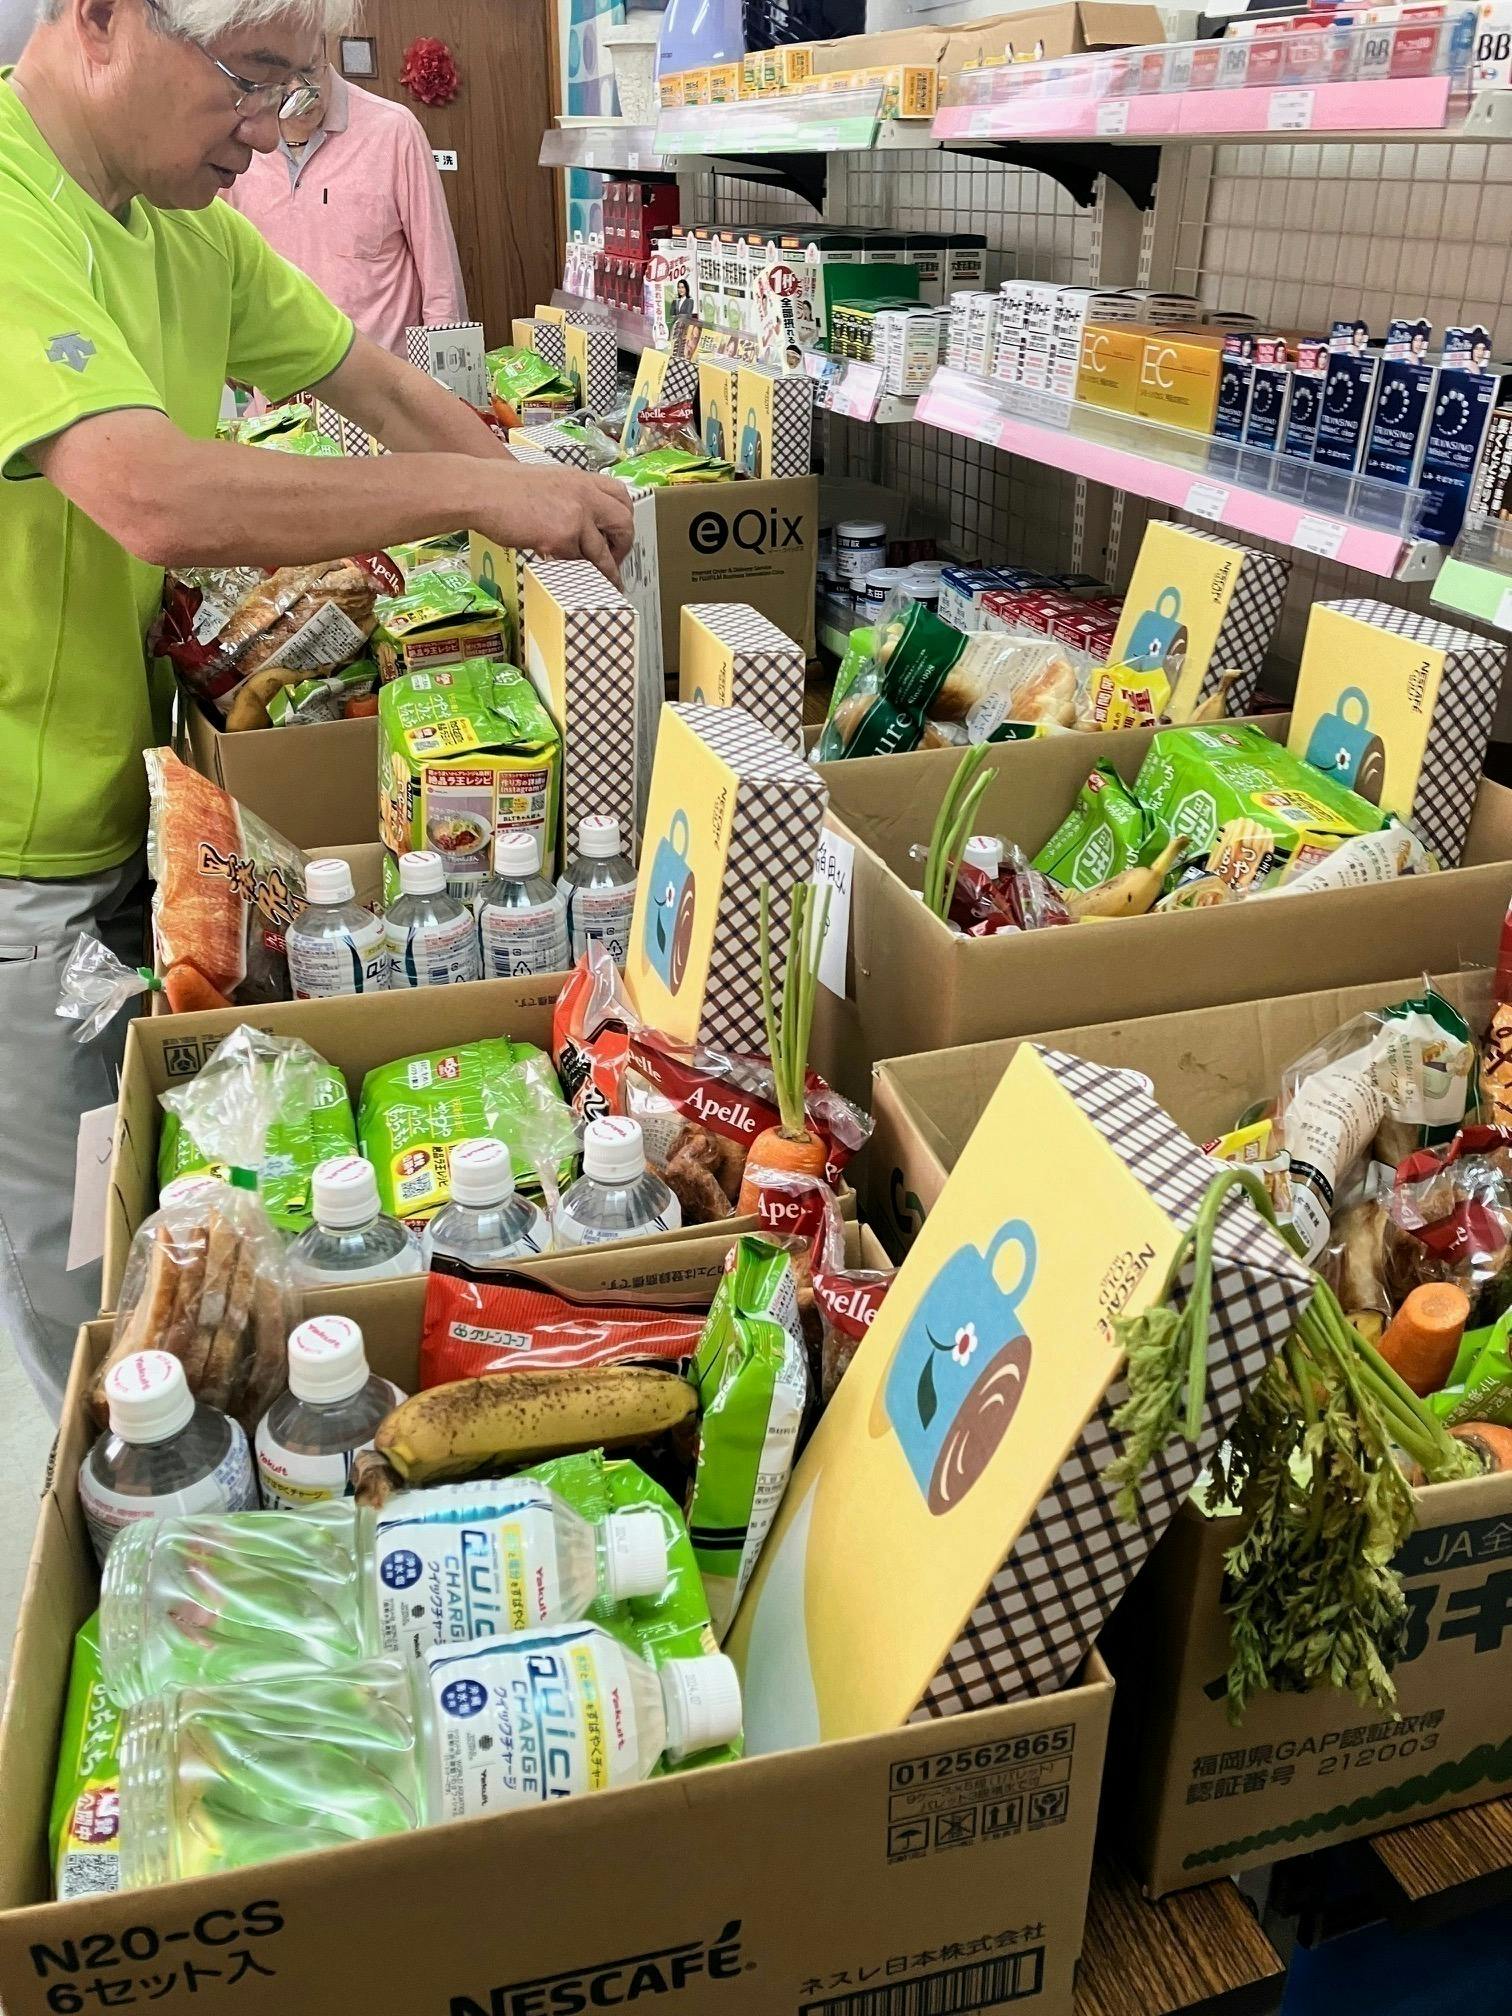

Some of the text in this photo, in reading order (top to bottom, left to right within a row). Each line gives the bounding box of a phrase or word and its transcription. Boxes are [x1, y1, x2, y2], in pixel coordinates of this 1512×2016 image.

[1081, 333, 1110, 372] EC
[1140, 345, 1178, 388] EC
[688, 507, 804, 555] eQix
[873, 712, 913, 757] ure
[686, 1087, 756, 1134] Apelle
[259, 1451, 288, 1477] Yakult
[443, 1555, 465, 1642] CHARG
[536, 1566, 548, 1622] Yakult
[493, 1686, 517, 1790] クイックチャージ
[511, 1679, 538, 1793] CHARGE
[612, 1687, 627, 1750] Yakult
[1191, 1708, 1446, 1777] 福岡県GAP認証取得
[896, 1729, 1069, 1786] 012562865
[1185, 1733, 1441, 1806] 認証番号 212003
[29, 1899, 285, 1978] N20-CS
[800, 1921, 1047, 1997] ネスレ日本株式会社
[46, 1950, 277, 2015] 6セット入
